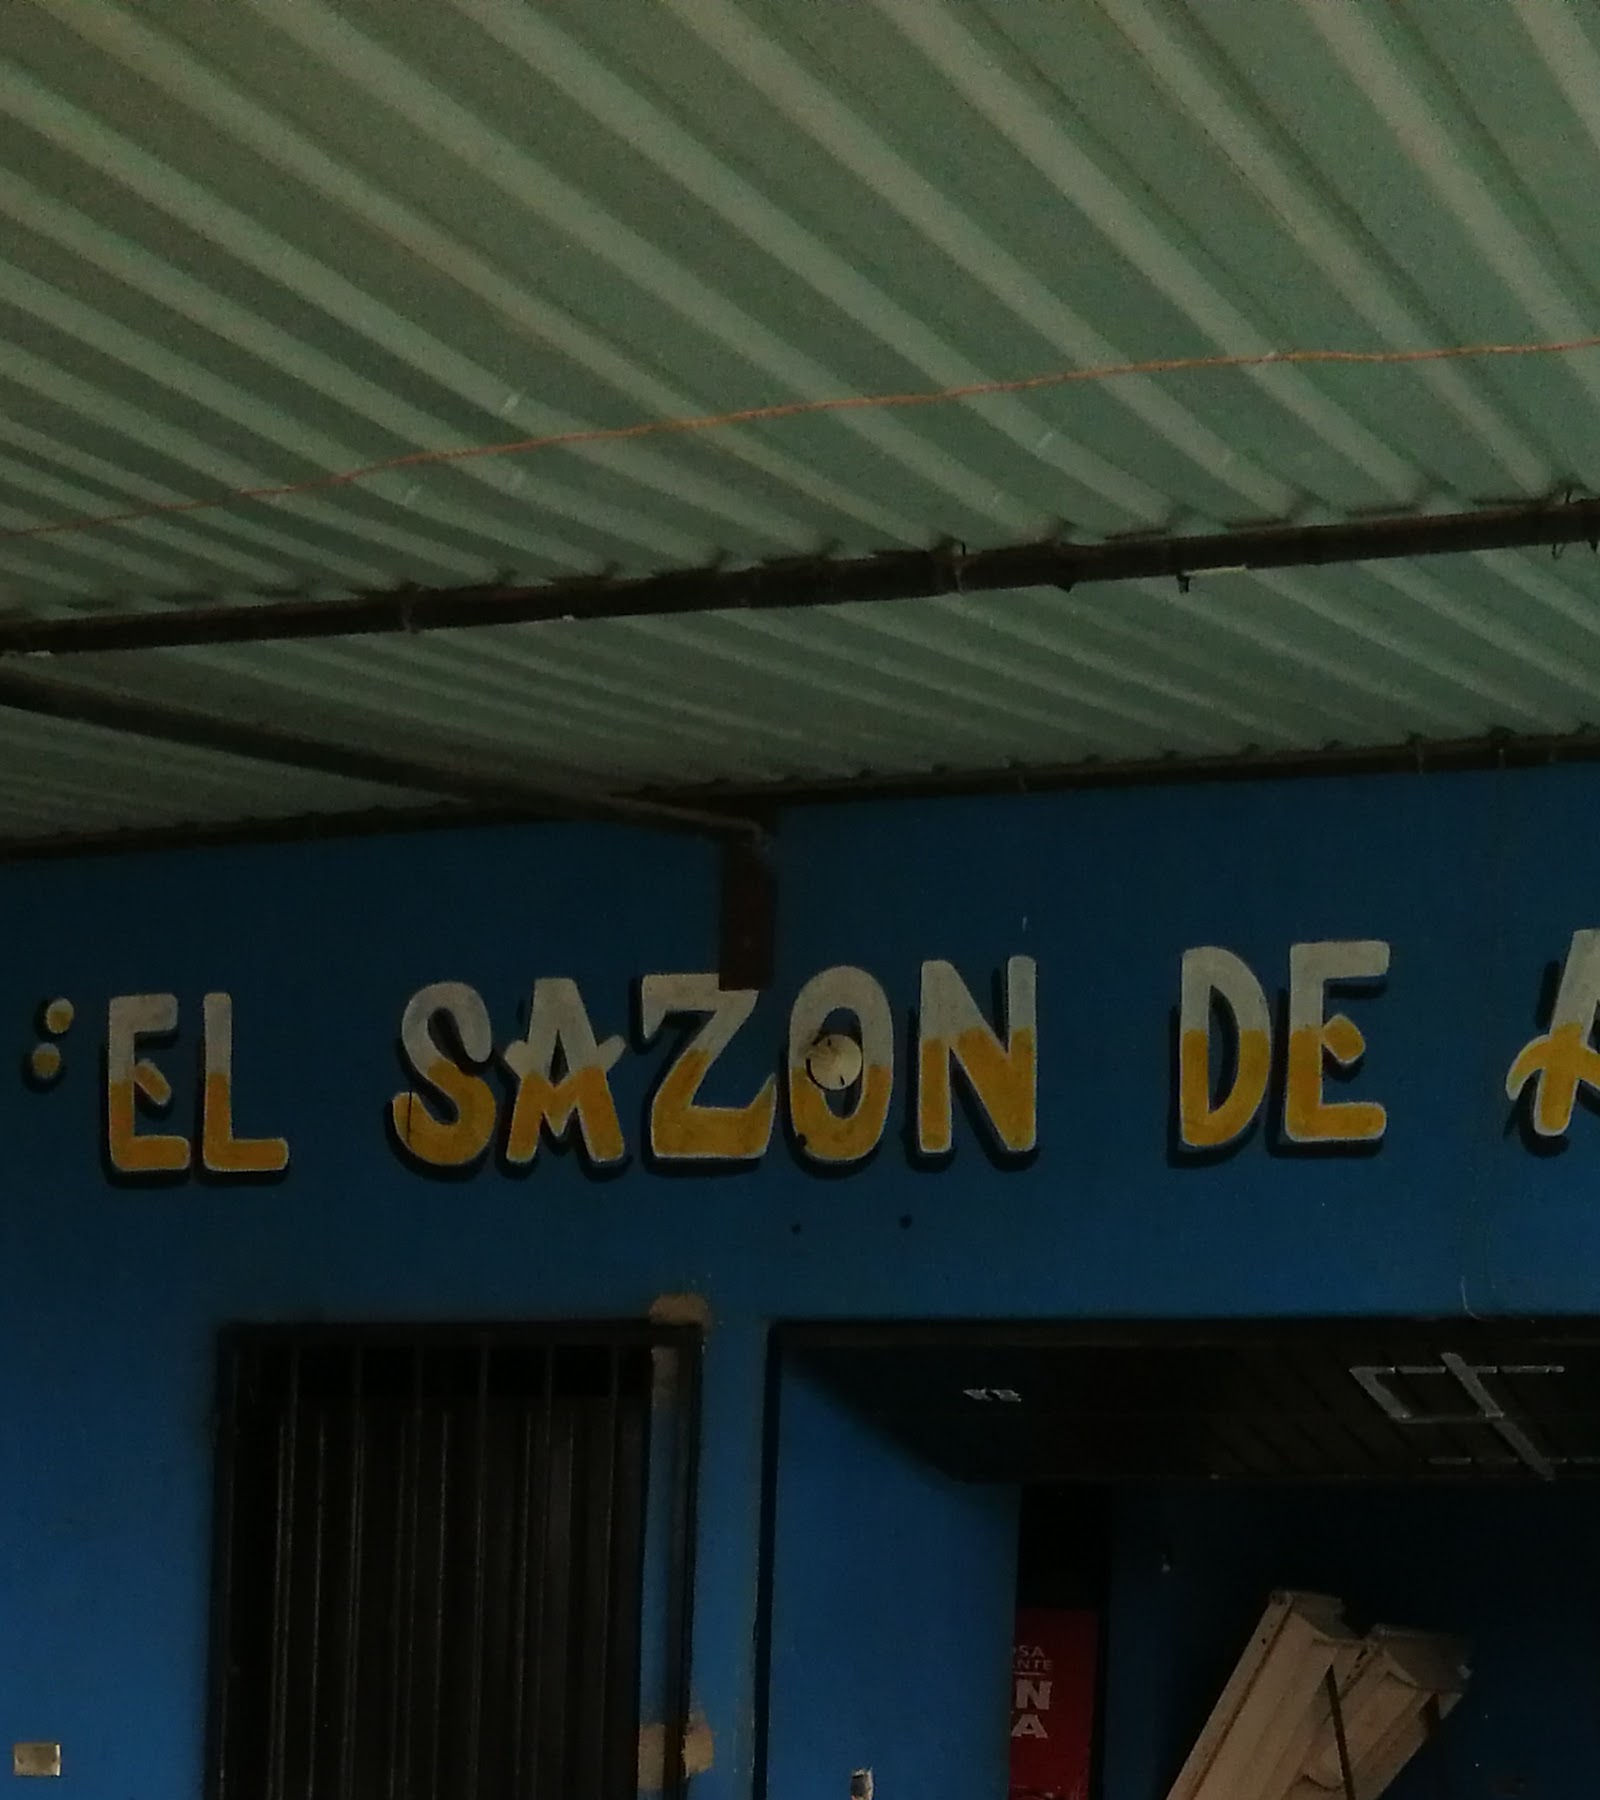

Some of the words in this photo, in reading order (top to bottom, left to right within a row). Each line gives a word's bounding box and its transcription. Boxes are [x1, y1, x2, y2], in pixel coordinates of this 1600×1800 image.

[107, 992, 289, 1173] EL
[392, 955, 1038, 1166] SAZON
[1179, 940, 1390, 1150] DE
